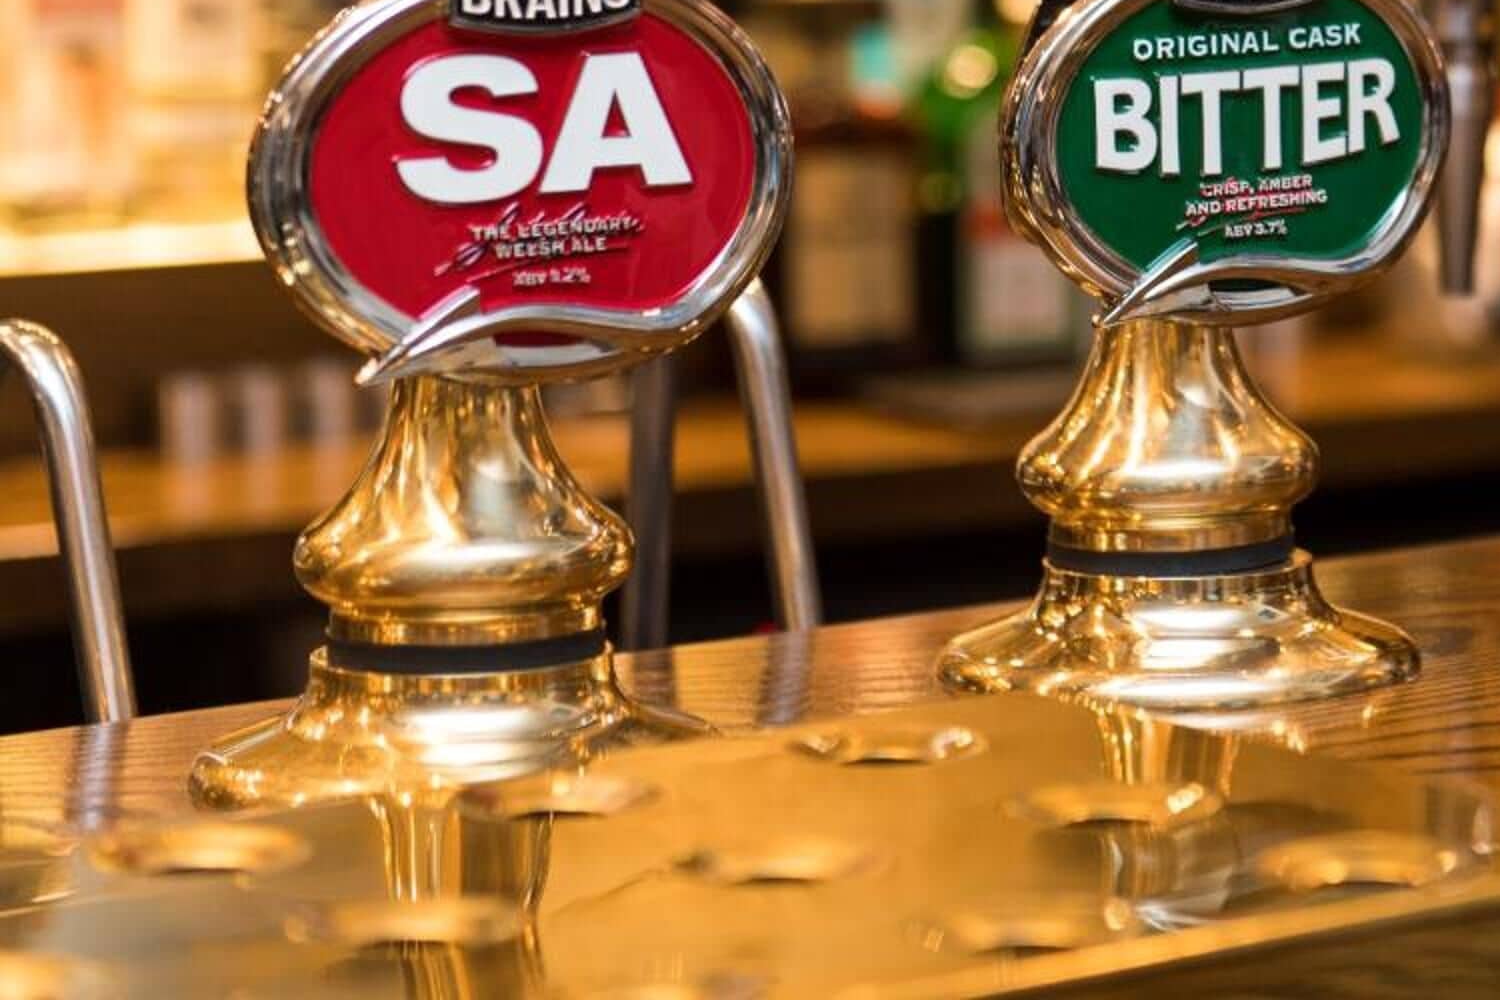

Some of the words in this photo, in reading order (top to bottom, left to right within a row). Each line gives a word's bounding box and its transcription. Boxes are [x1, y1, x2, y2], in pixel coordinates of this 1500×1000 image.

[1133, 31, 1280, 61] ORIGINAL
[1288, 23, 1362, 50] CASK
[396, 51, 693, 204] SA
[1093, 58, 1401, 176] BITTER
[1258, 173, 1313, 191] AMBER
[1184, 201, 1223, 216] AND
[1223, 188, 1328, 213] REFRESHING
[469, 220, 512, 241] THE
[571, 236, 608, 253] ALE
